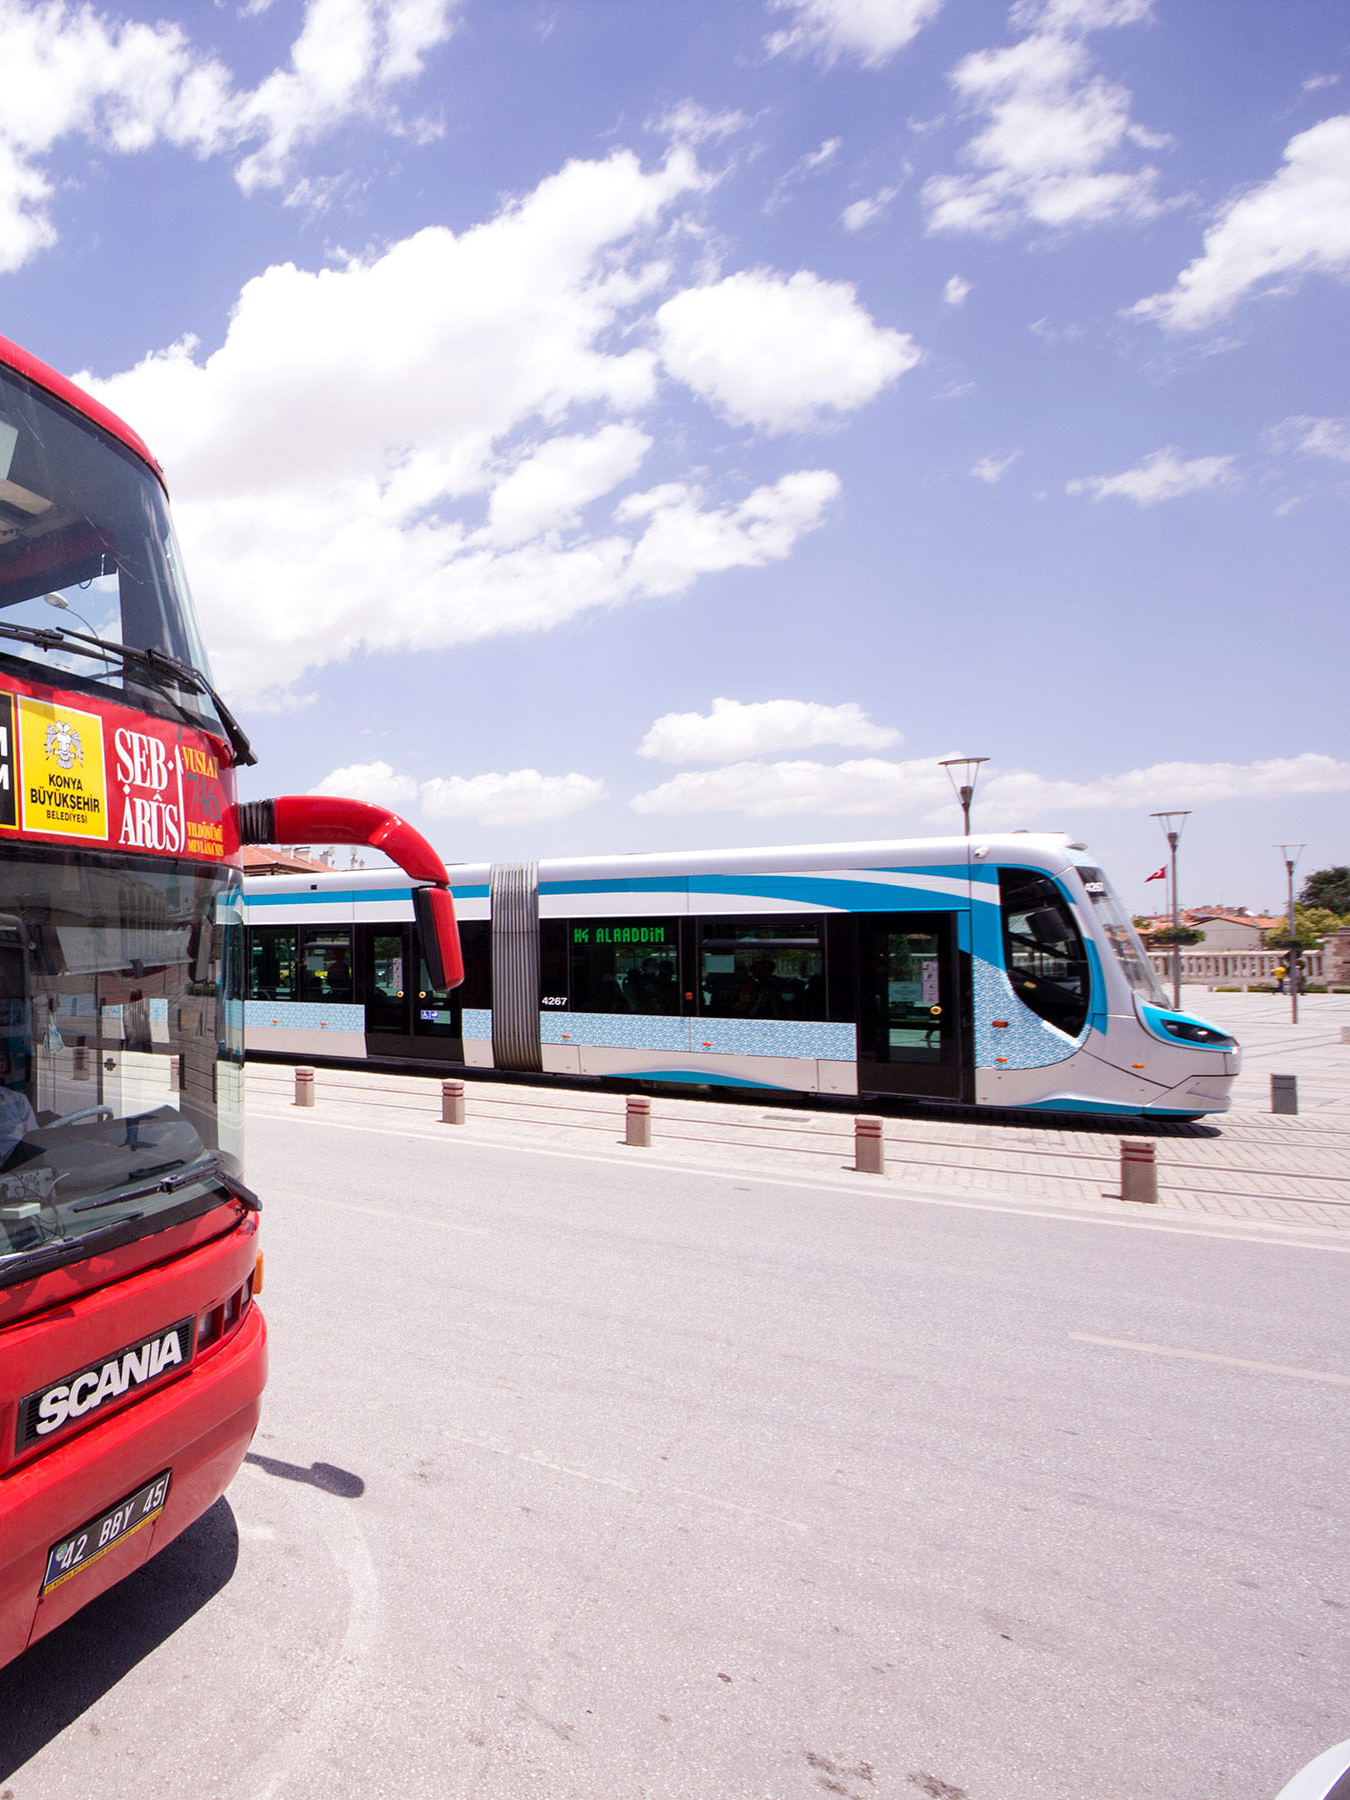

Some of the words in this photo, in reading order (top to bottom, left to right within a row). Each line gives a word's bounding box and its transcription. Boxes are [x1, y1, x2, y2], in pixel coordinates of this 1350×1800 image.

[182, 746, 218, 779] VUSLAT
[48, 773, 84, 791] KONYA
[30, 784, 101, 815] BÜYÜKŞEHİR
[46, 808, 88, 825] BELEDİYESİ
[541, 996, 568, 1007] 4267
[35, 1330, 182, 1435] SCANIA
[60, 1534, 88, 1569] 42
[98, 1502, 135, 1549] BBY
[142, 1480, 165, 1513] 45
